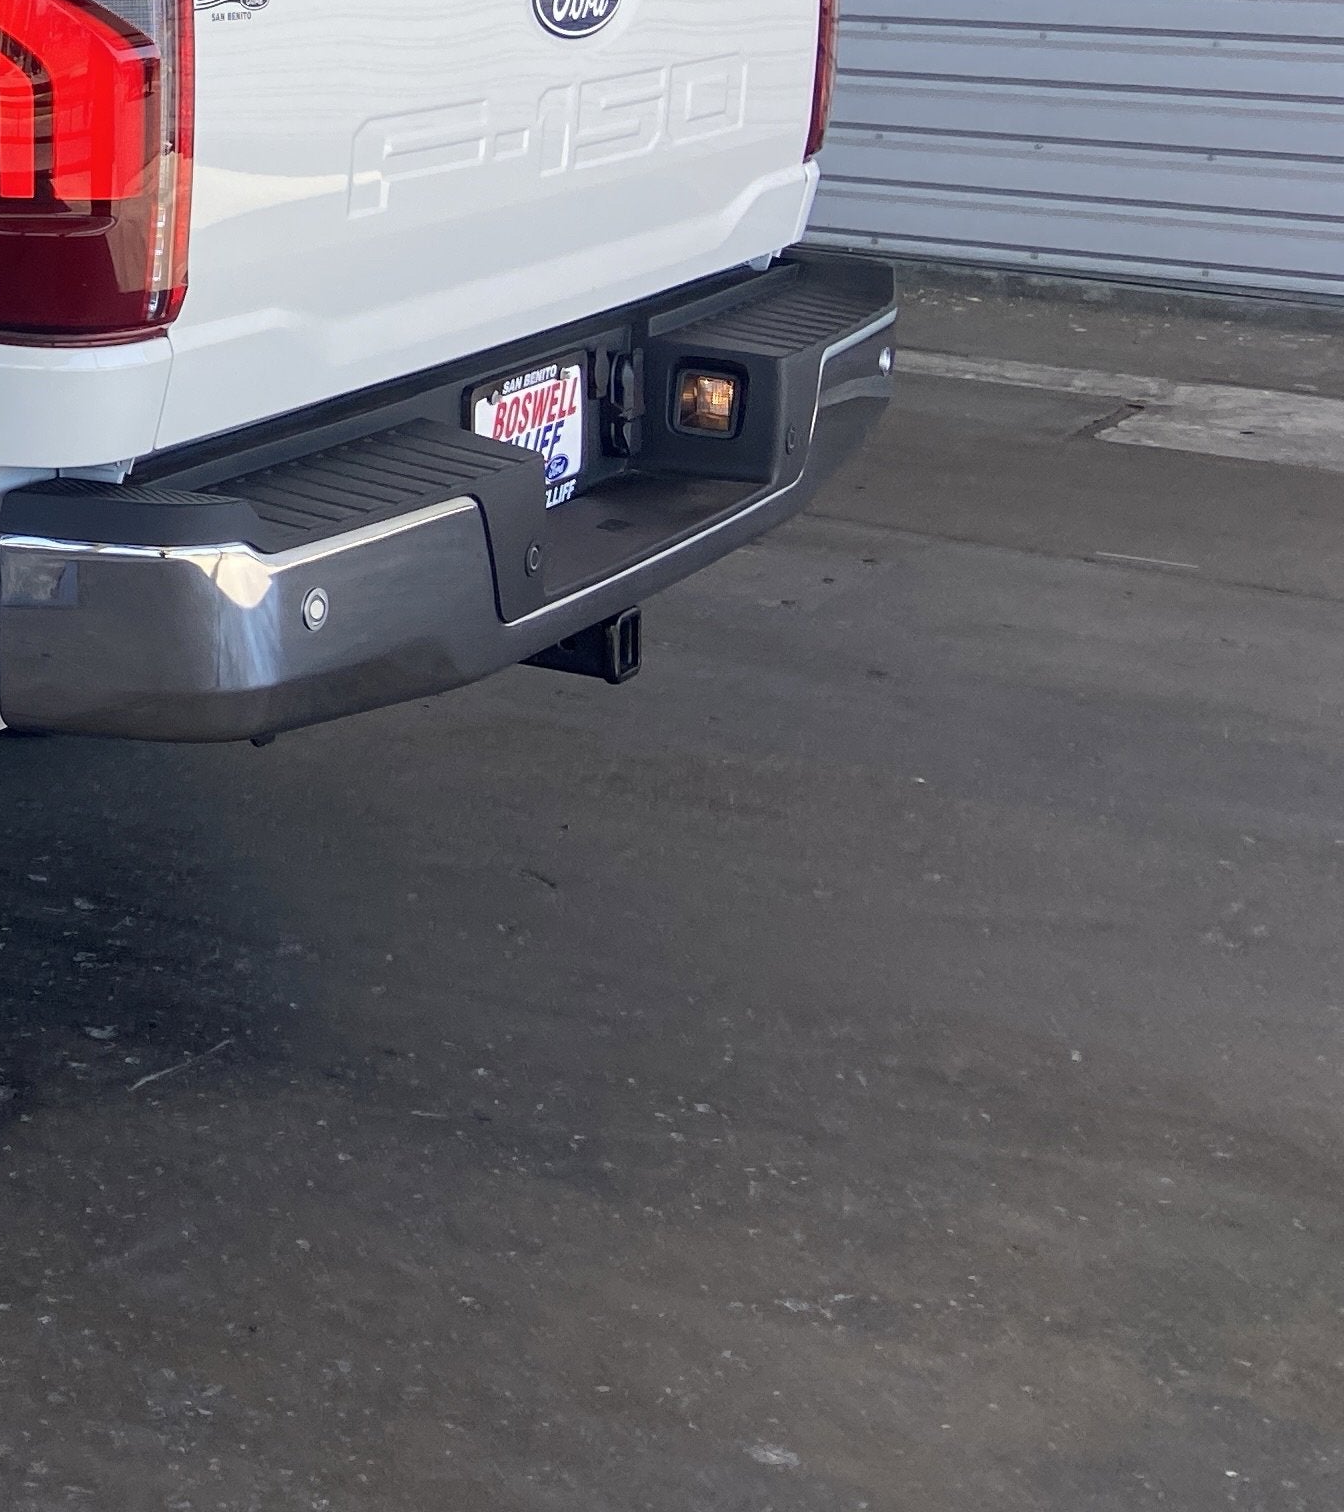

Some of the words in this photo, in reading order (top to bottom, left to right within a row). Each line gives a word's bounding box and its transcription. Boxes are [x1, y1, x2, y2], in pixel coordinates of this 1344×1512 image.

[211, 13, 225, 22] SAN
[227, 11, 252, 21] BENITO
[502, 376, 523, 394] SAN
[523, 364, 558, 387] BENITO
[492, 377, 579, 441] BOSWELL
